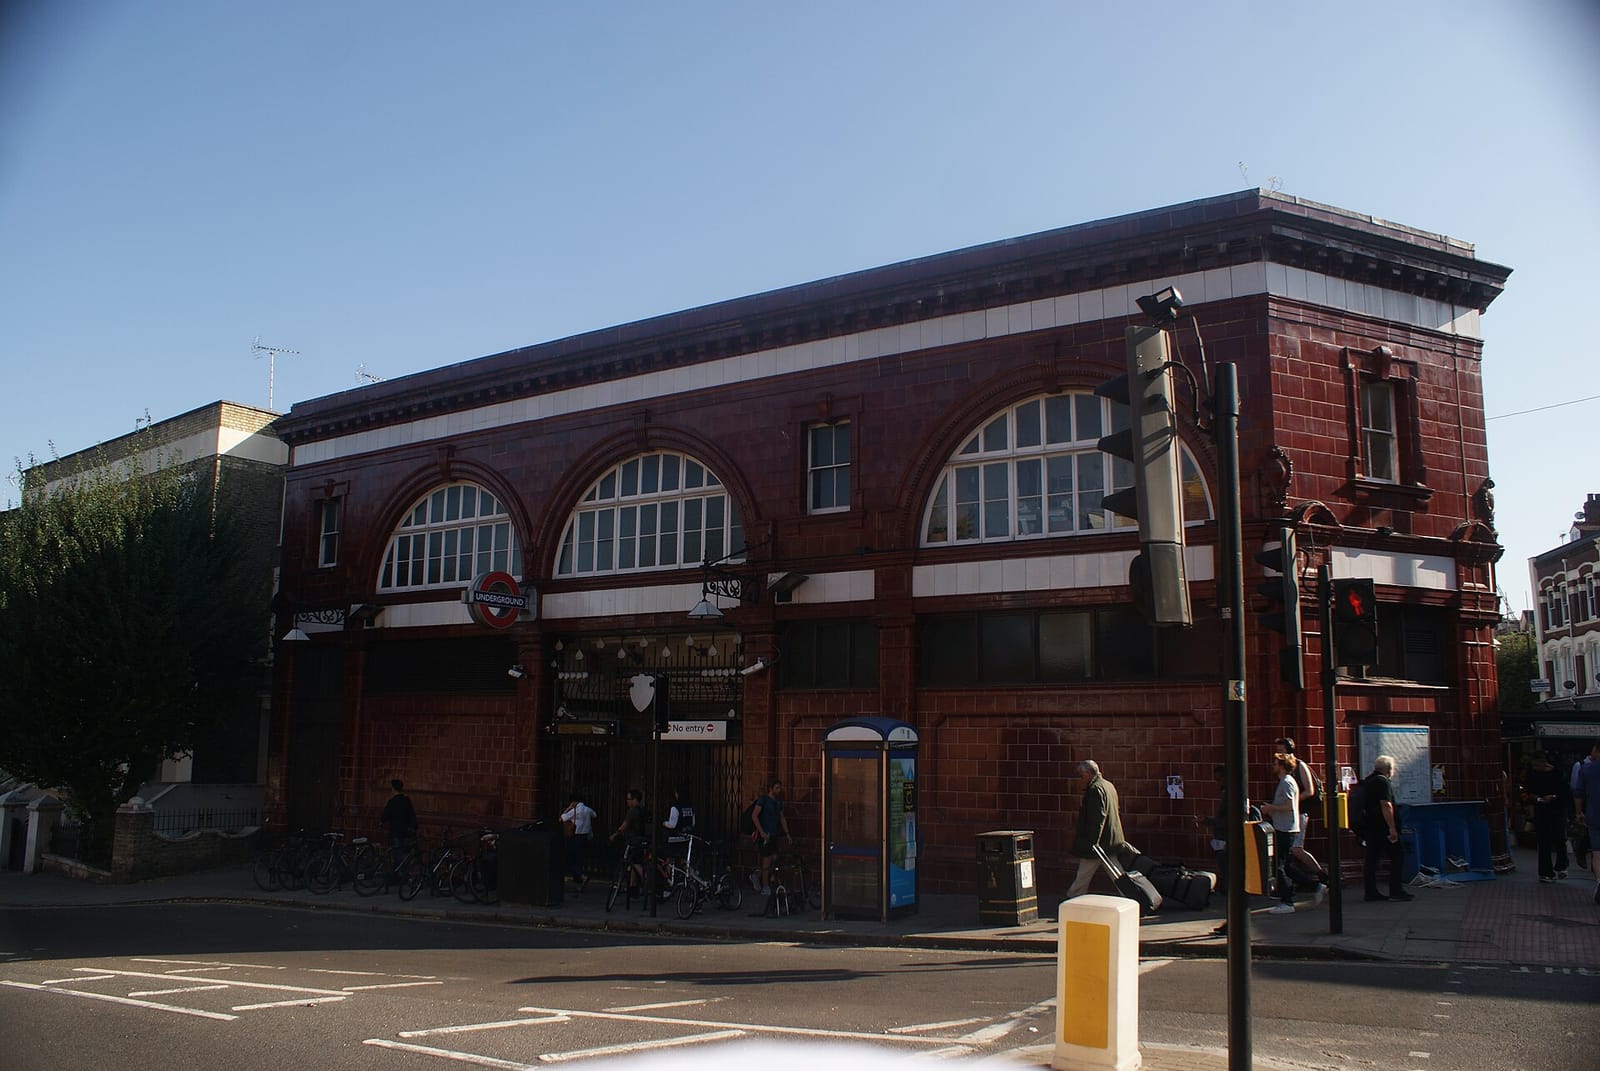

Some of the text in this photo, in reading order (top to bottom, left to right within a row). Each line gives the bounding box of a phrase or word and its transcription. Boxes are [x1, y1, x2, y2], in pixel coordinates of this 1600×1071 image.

[475, 592, 524, 606] UNDERGROUND
[673, 724, 705, 734] No entry
